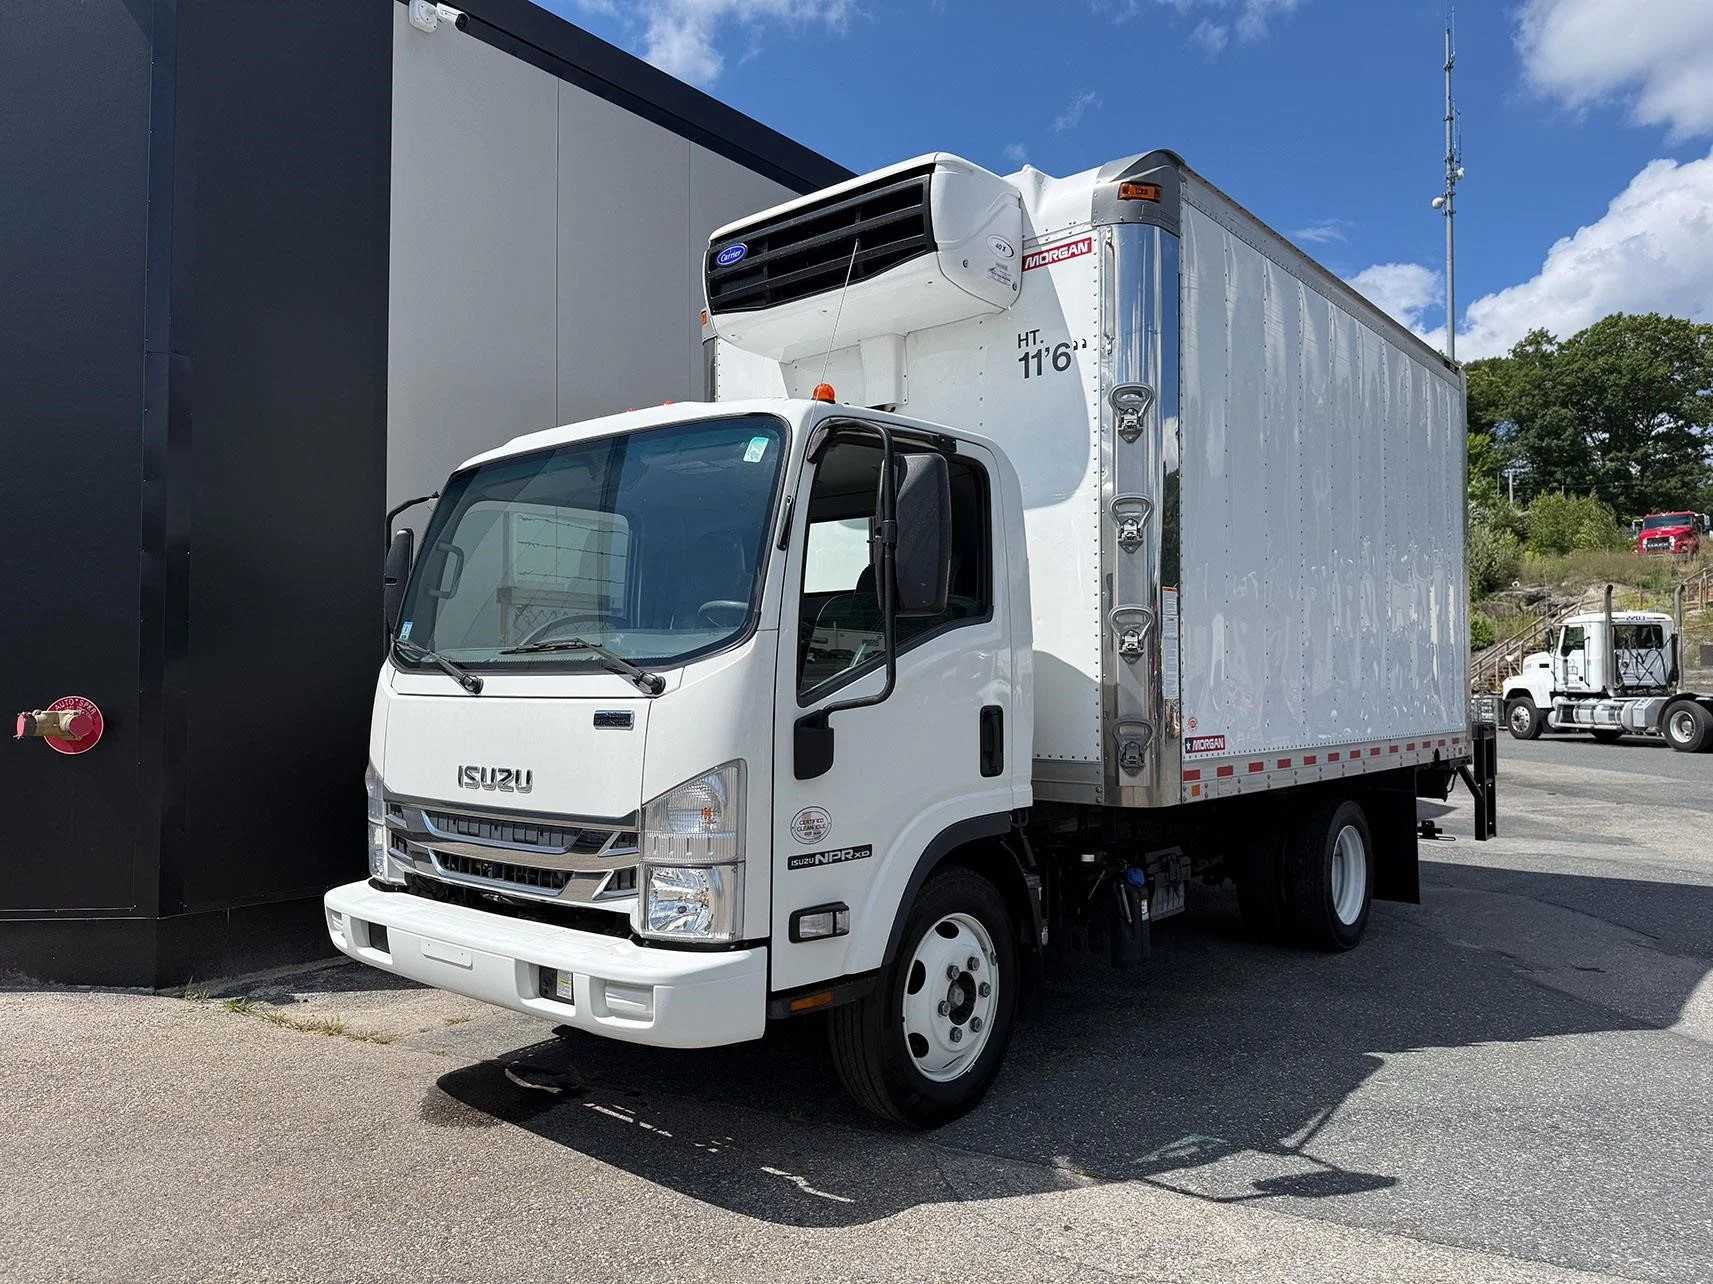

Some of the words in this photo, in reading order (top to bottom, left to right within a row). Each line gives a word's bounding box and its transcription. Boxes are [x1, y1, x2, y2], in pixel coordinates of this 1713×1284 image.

[720, 249, 742, 262] Carrier
[1024, 240, 1090, 269] MORGAN
[1017, 329, 1044, 349] HT.
[54, 699, 74, 710] AUTO
[79, 700, 97, 715] SPKR
[1192, 737, 1224, 751] MORGAN
[457, 765, 534, 794] ISUZU
[799, 818, 824, 826] CERTIFIED
[791, 857, 814, 866] ISUZU
